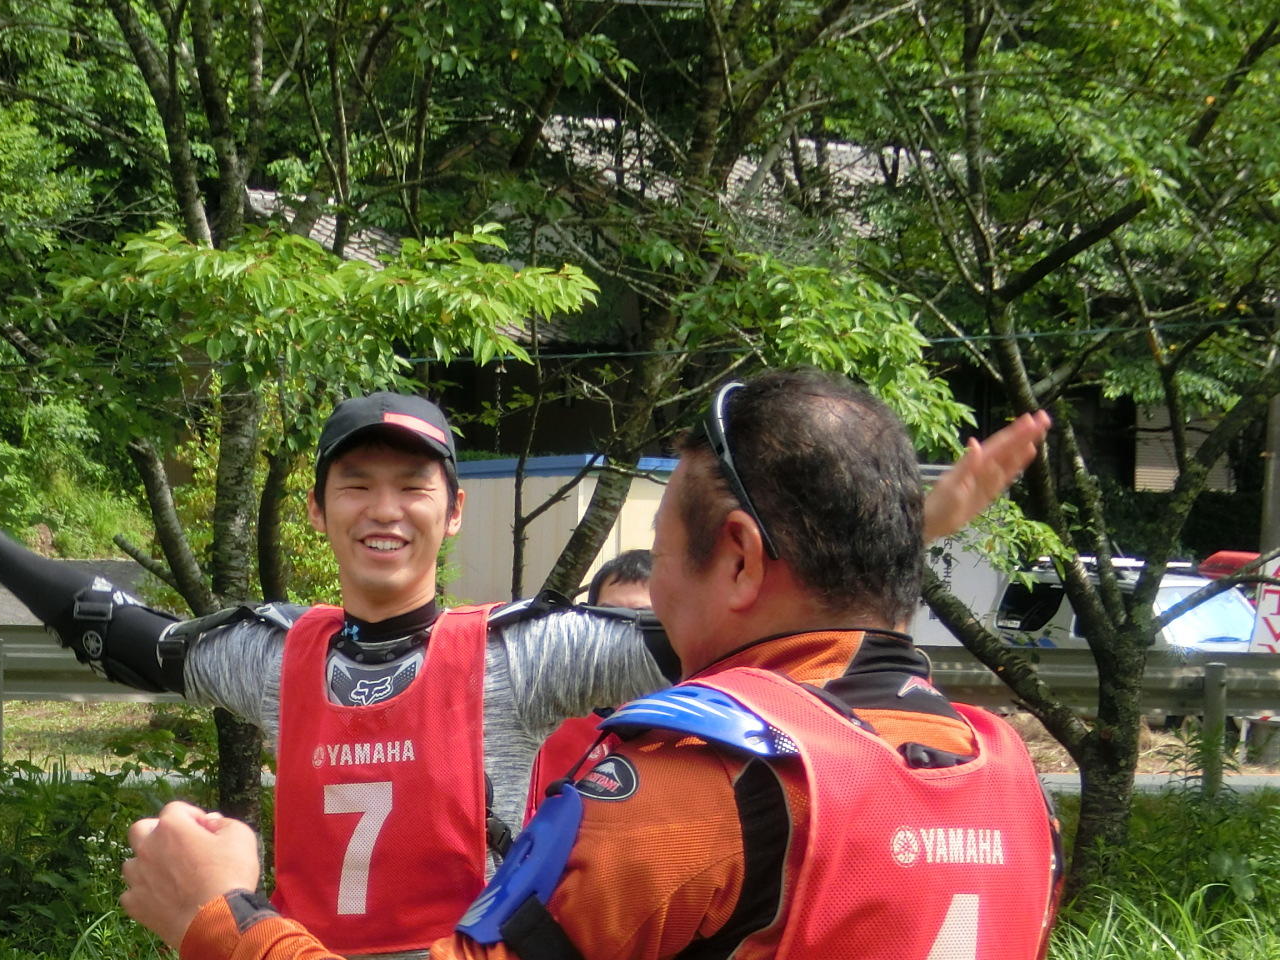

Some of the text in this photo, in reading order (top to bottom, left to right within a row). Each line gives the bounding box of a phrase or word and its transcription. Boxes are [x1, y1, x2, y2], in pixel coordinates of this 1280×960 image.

[327, 740, 416, 766] YAMAHA
[324, 781, 393, 916] 7
[920, 828, 1005, 865] YAMAHA
